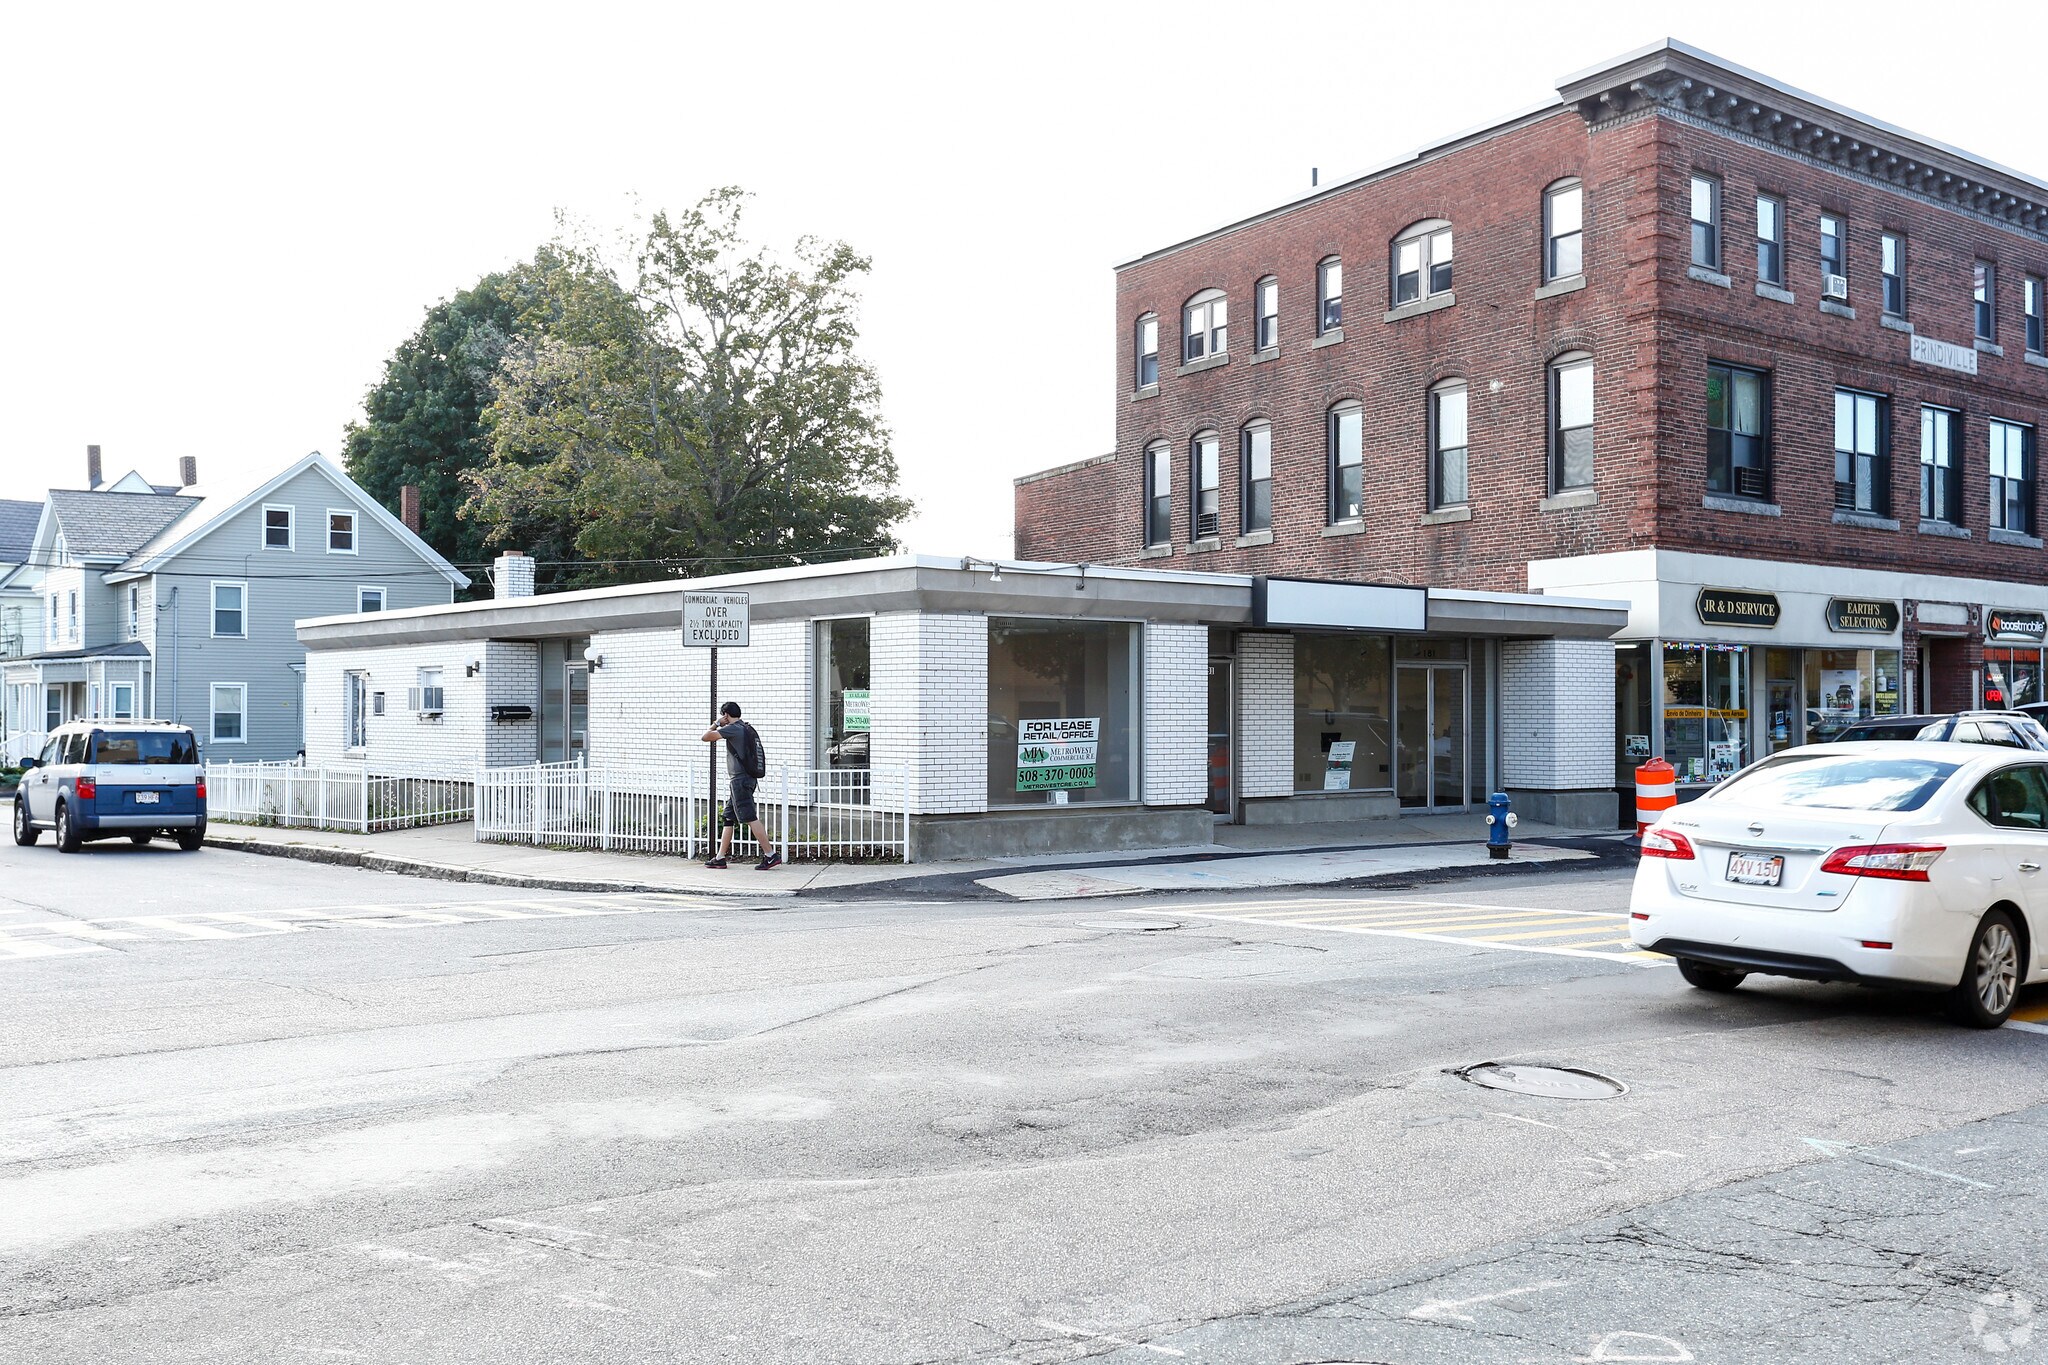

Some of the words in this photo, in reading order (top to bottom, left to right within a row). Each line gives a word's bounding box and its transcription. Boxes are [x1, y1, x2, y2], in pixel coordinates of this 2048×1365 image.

[1913, 338, 1975, 370] PRINDIVILLE
[684, 595, 717, 604] COMMERCIAL
[723, 596, 748, 605] VEHICLES
[706, 606, 728, 618] OVER
[1703, 599, 1716, 613] JR
[1717, 602, 1726, 614] &
[1727, 602, 1735, 614] D
[1735, 602, 1776, 617] SERVICE
[1847, 602, 1881, 615] EARTH'S
[701, 619, 716, 629] TONS
[717, 619, 743, 629] CAPACITY
[1839, 615, 1888, 629] SELECTIONS
[692, 629, 740, 641] EXCLUDED
[1027, 721, 1052, 732] FOR
[1053, 720, 1093, 731] LEASE
[1023, 730, 1095, 741] RETAIL/OFFICE
[1050, 746, 1093, 756] METROWEST
